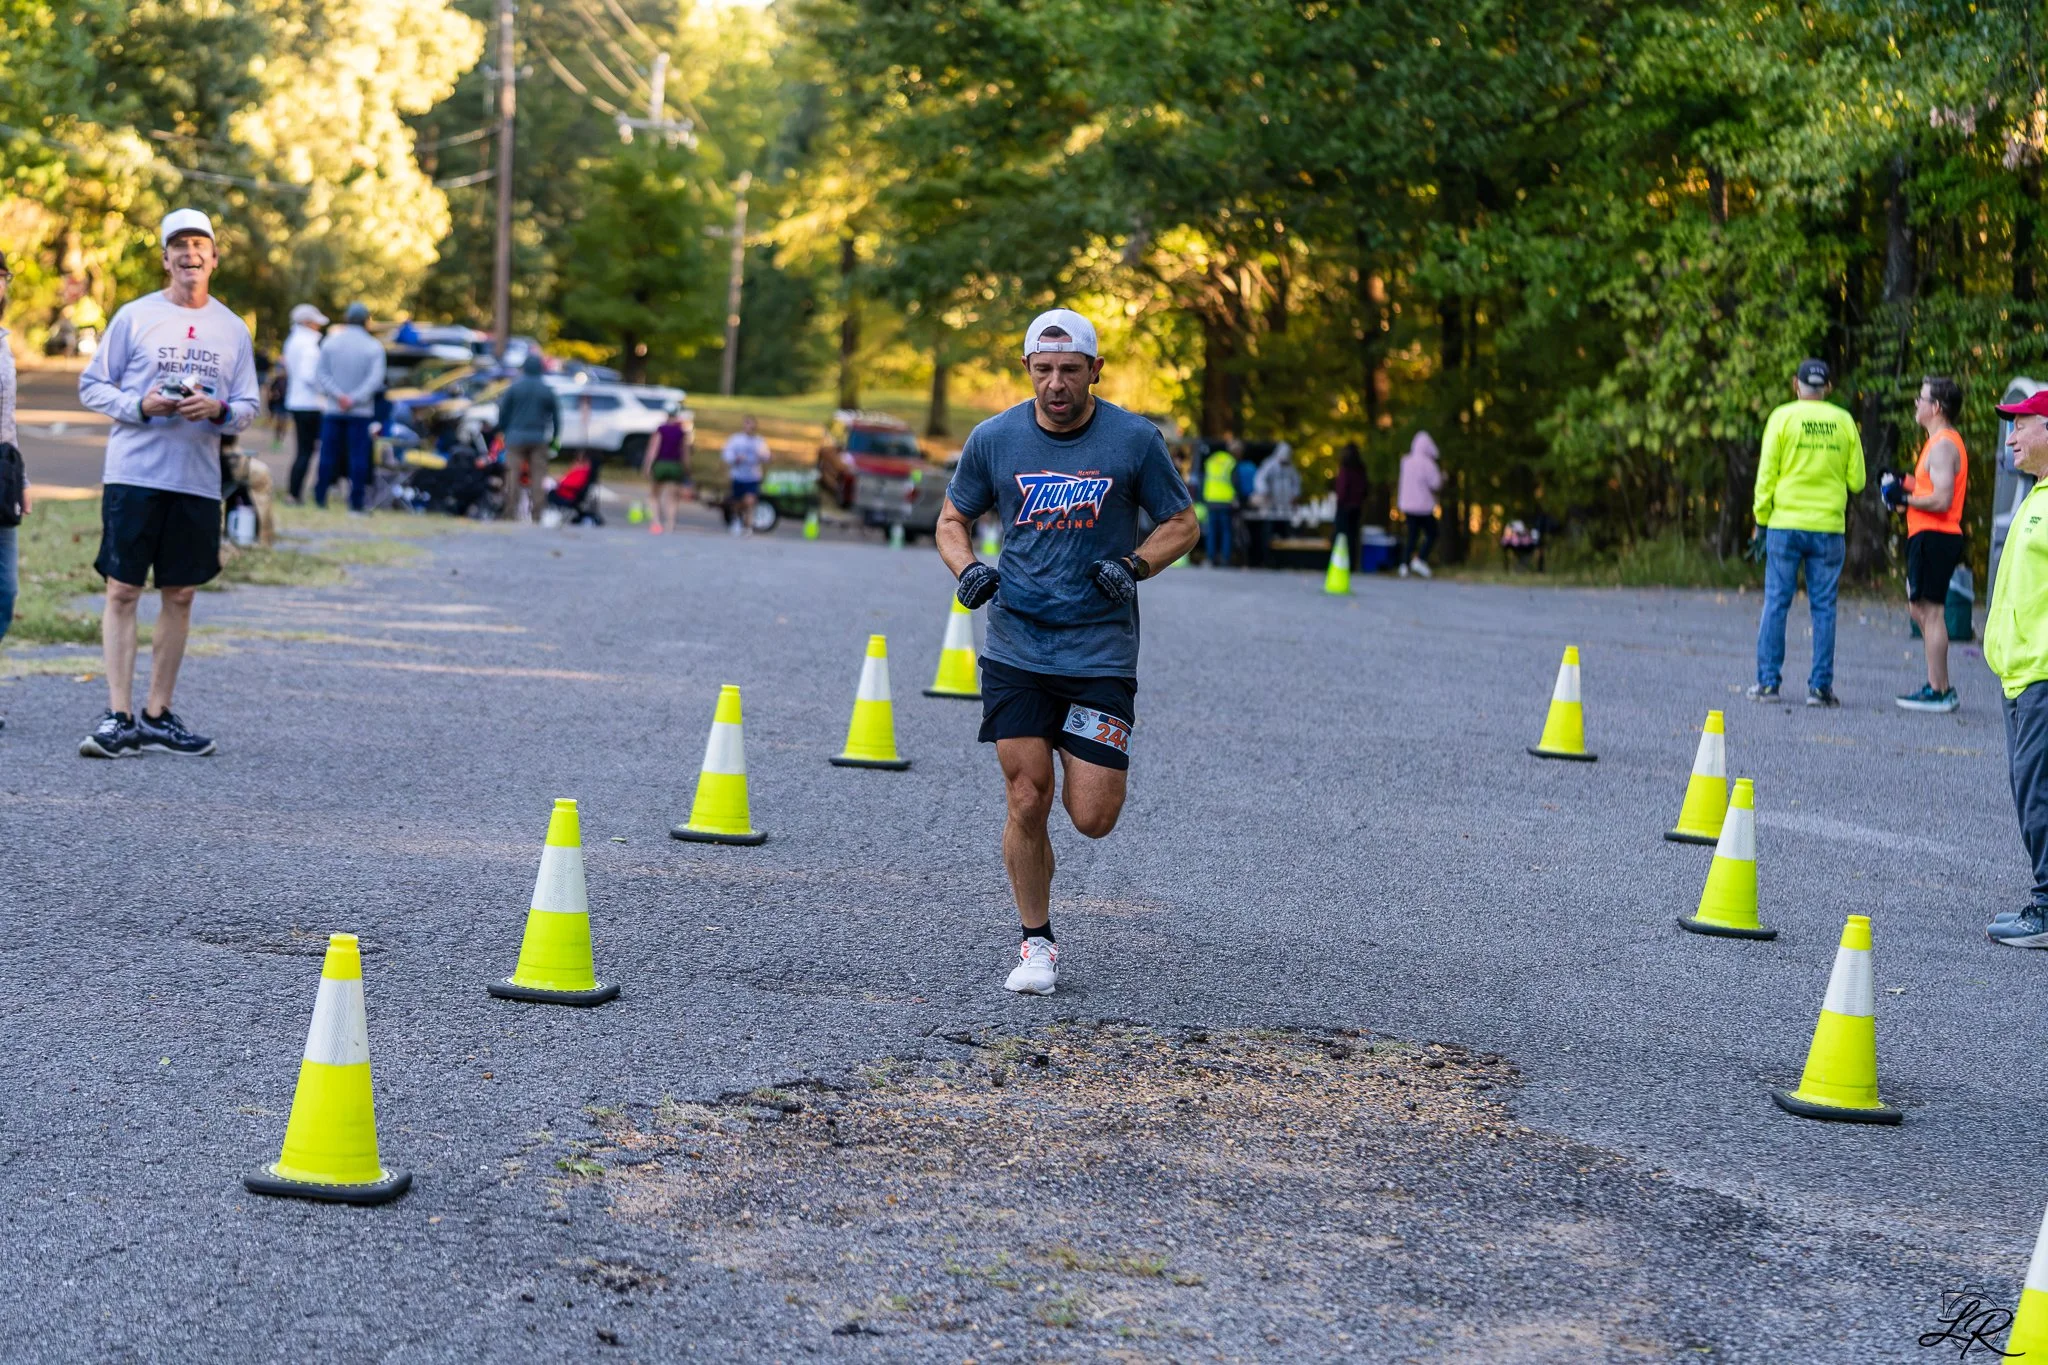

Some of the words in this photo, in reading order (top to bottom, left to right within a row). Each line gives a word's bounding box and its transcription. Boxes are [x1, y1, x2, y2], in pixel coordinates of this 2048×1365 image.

[158, 347, 179, 359] ST.
[182, 348, 220, 366] JUDE
[158, 361, 220, 378] MEMPHIS
[1014, 470, 1113, 524] THUNDER
[1036, 519, 1094, 530] RACING
[1094, 723, 1128, 752] 246
